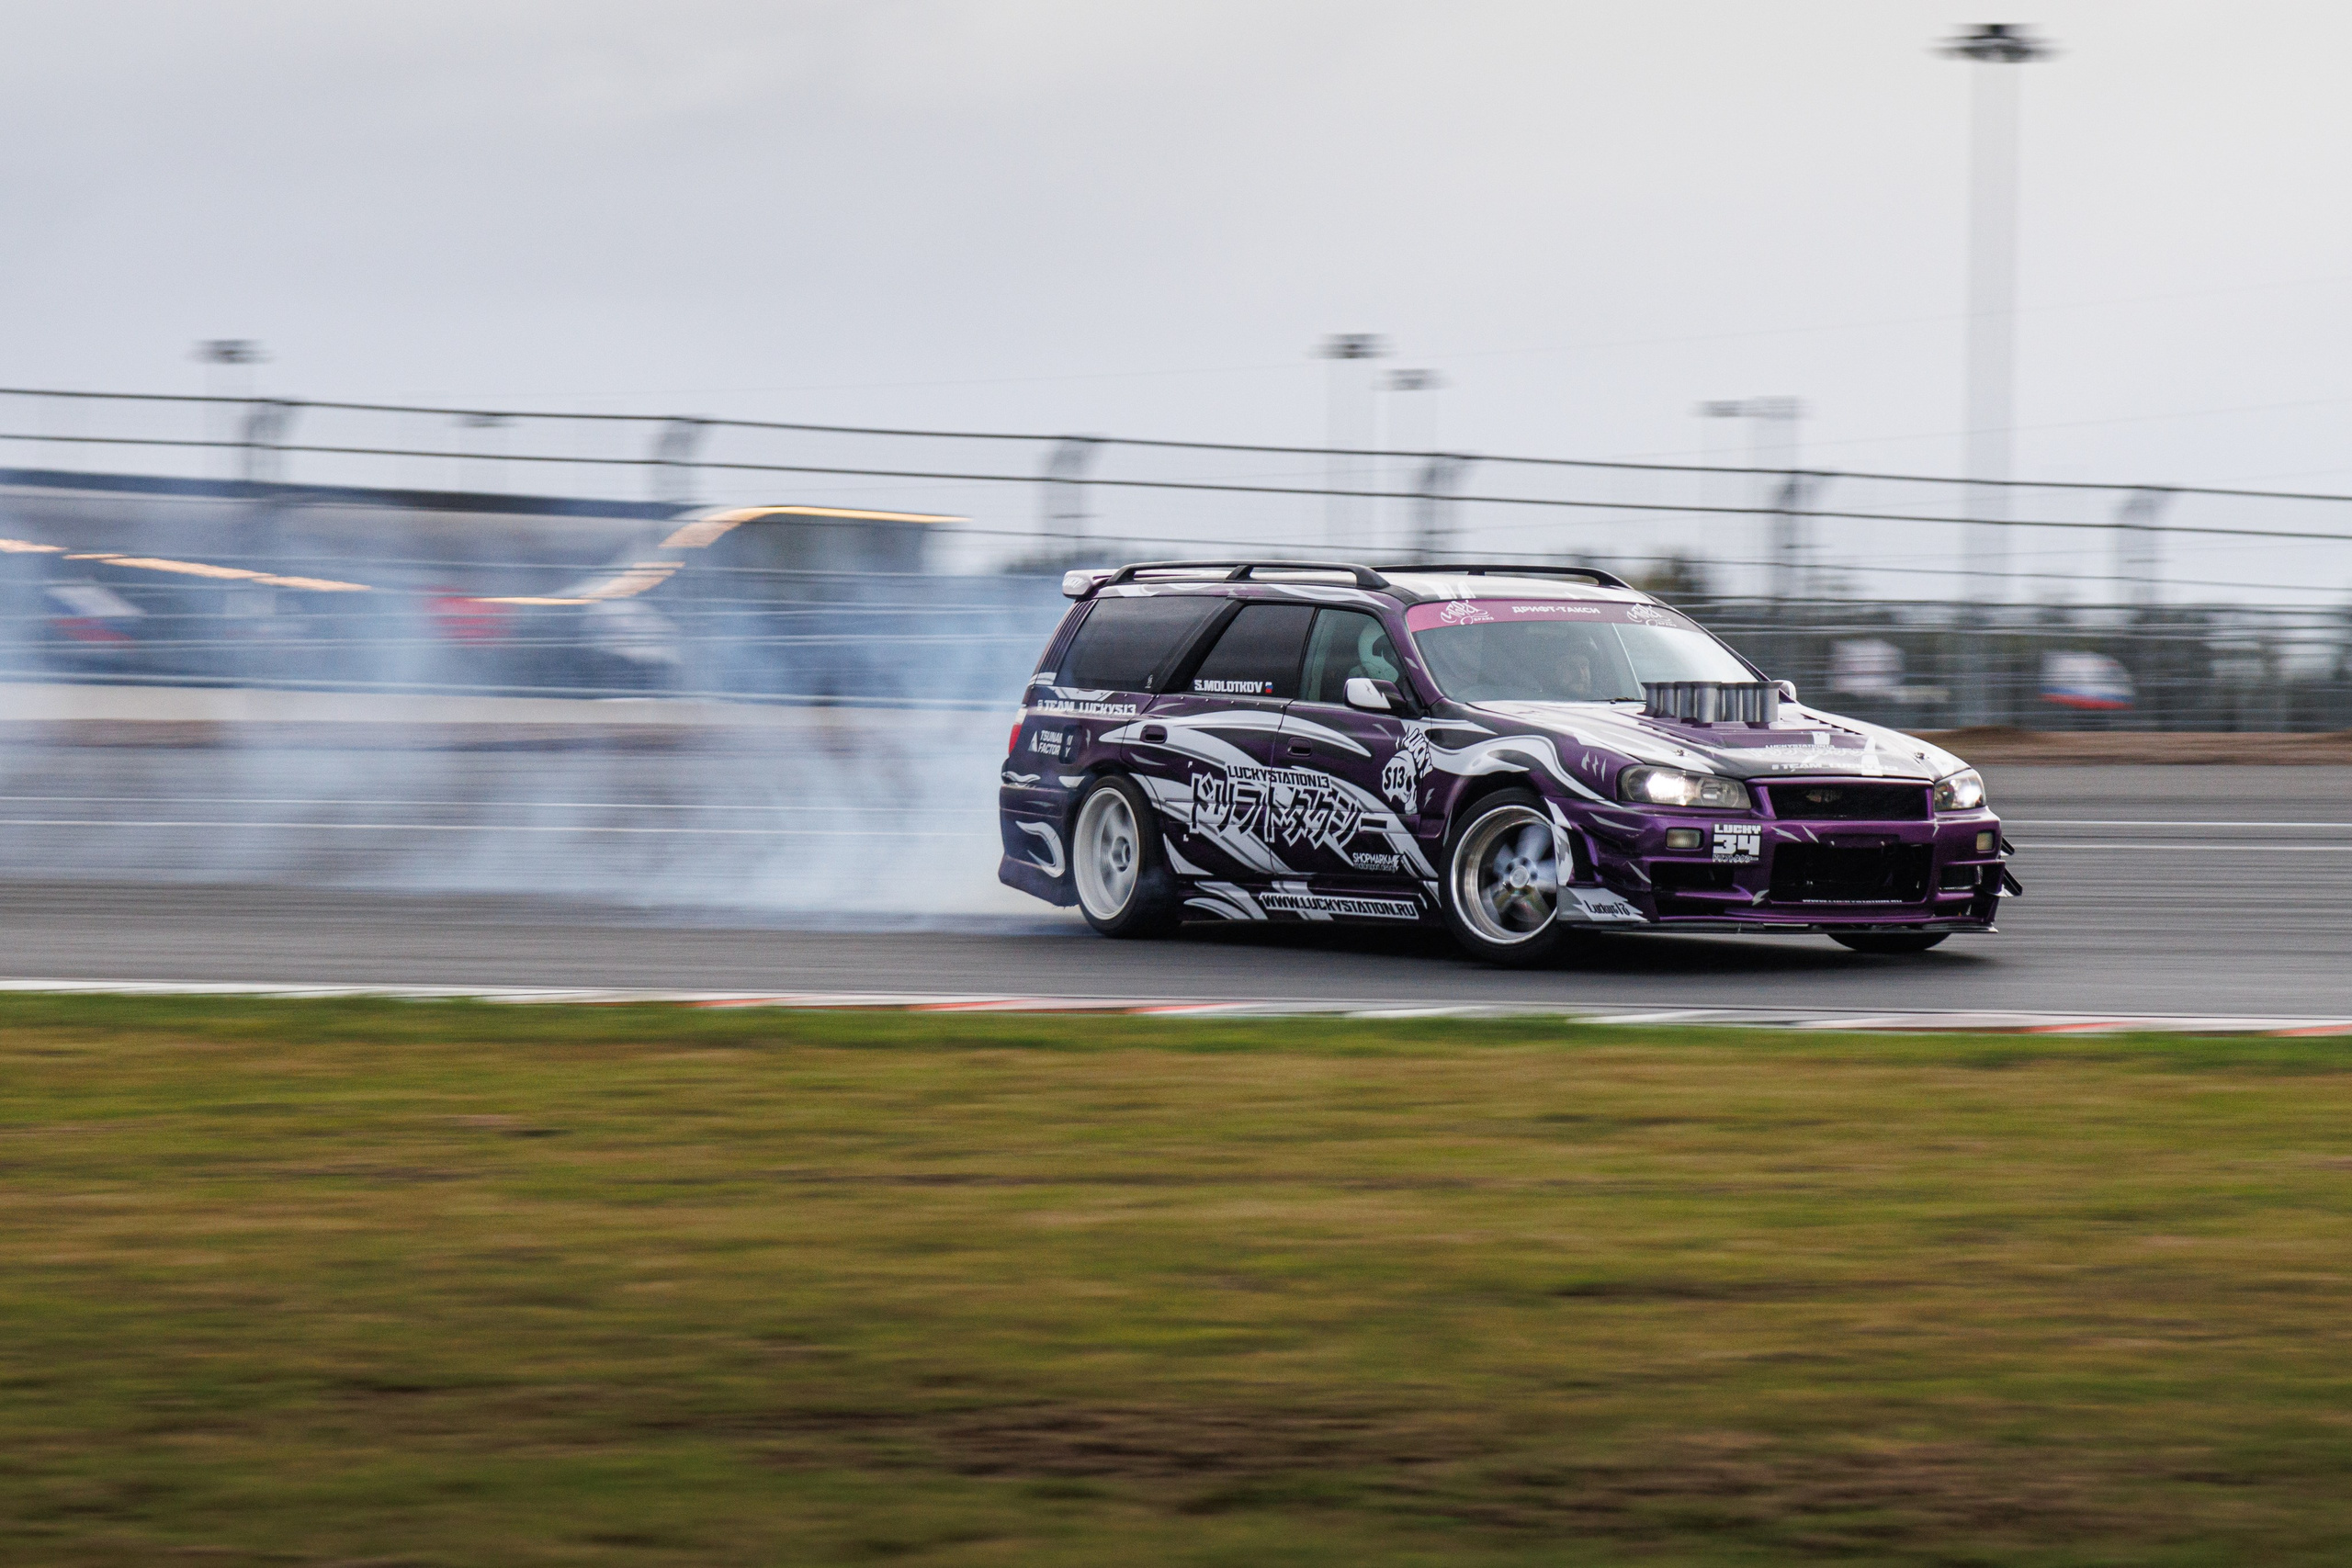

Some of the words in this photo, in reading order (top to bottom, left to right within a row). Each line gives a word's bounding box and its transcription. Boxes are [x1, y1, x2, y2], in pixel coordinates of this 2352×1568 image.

[1511, 605, 1601, 615] ДРИФТ-ТАКСИ
[1194, 679, 1263, 694] S.MOLOTKOV
[1037, 741, 1071, 758] FACTORY
[1227, 765, 1331, 789] LUCKYSTATION13
[1383, 765, 1406, 791] S13
[1714, 824, 1761, 834] LUCKY
[1713, 834, 1761, 855] 34
[1261, 895, 1417, 917] WWW.LUCKYSTATION.RU
